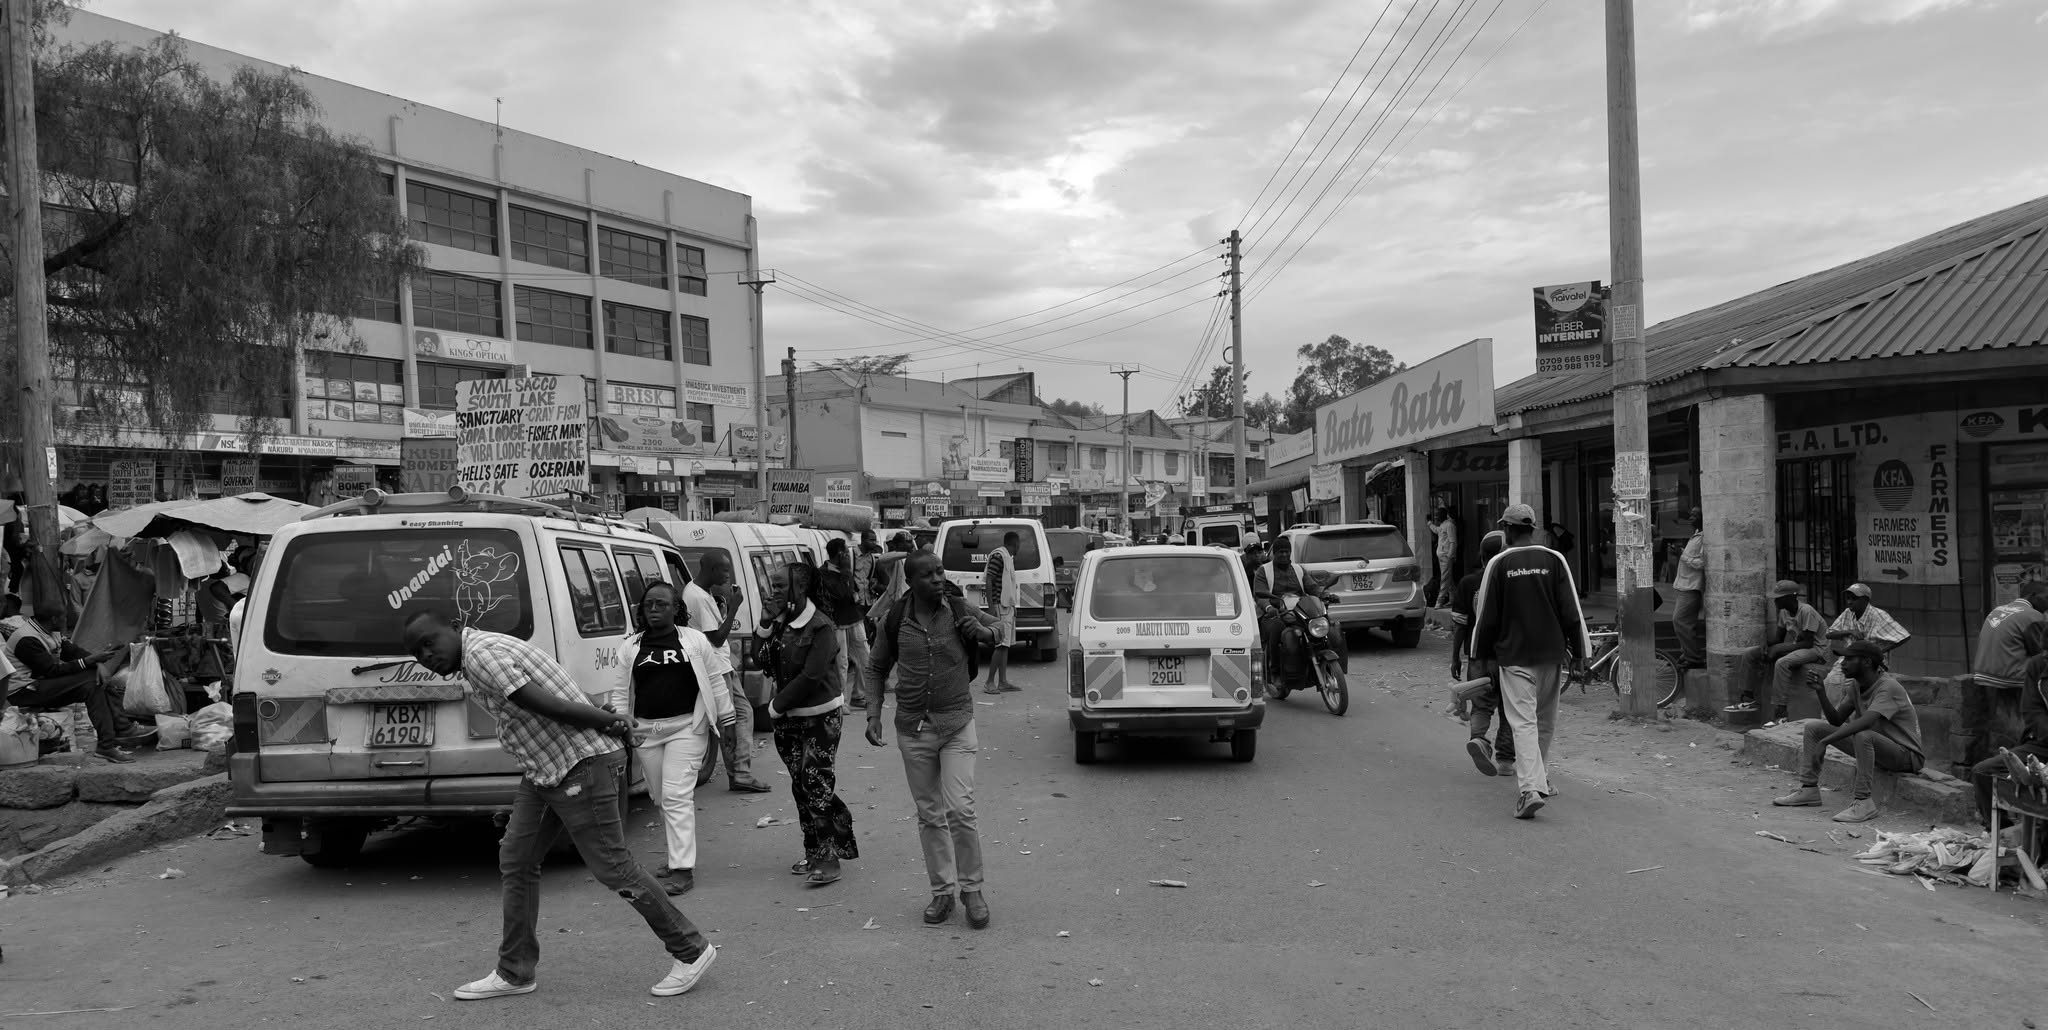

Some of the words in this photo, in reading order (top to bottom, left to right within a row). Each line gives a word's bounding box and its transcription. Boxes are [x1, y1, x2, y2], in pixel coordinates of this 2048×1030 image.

[1552, 291, 1587, 303] naivatel
[1554, 321, 1584, 332] FIBER
[1539, 329, 1600, 343] INTERNET
[449, 347, 474, 359] KINGS
[477, 351, 509, 362] OPTICAL
[470, 380, 512, 395] MML
[515, 376, 558, 392] SACCO
[712, 384, 747, 396] INVESTMENTS
[467, 394, 512, 411] SOUTH
[520, 391, 556, 407] LAKE
[614, 386, 664, 404] BRISK
[459, 409, 524, 428] SANCTUARY
[527, 406, 555, 422] CRAY
[556, 404, 581, 420] FISH
[1322, 403, 1374, 457] Bata
[1387, 370, 1465, 440] Bata
[1967, 415, 1995, 425] KFA
[459, 427, 486, 446] SOPA
[489, 424, 526, 442] LODGE
[527, 424, 559, 442] FISHER
[642, 438, 662, 446] 2300
[1833, 422, 1888, 449] LTD.
[220, 439, 236, 449] NSL
[311, 440, 335, 448] NAROK
[496, 442, 527, 460] LODGE
[530, 440, 584, 461] KAMERE
[462, 465, 491, 481] HELL'S
[494, 463, 519, 479] GATE
[529, 460, 585, 478] OSERIAN
[224, 476, 254, 486] GOVERNOR
[1880, 469, 1907, 487] KFA
[338, 482, 371, 491] BOMET
[772, 482, 810, 493] KINAMBA
[770, 503, 792, 513] GUEST
[794, 504, 810, 514] INN
[1928, 444, 1950, 567] FARMERS
[1873, 517, 1920, 532] FARMERS'
[1868, 534, 1921, 548] SUPERMARKET
[1874, 550, 1913, 565] NAIVASHA
[388, 544, 453, 609] Unandai
[1507, 568, 1540, 578] Fishbone
[1135, 623, 1163, 636] MARUTI
[1164, 622, 1190, 636] UNITED
[1157, 656, 1182, 670] KCP
[1151, 671, 1182, 684] 290U
[386, 706, 421, 724] KBX
[375, 726, 421, 744] 619Q
